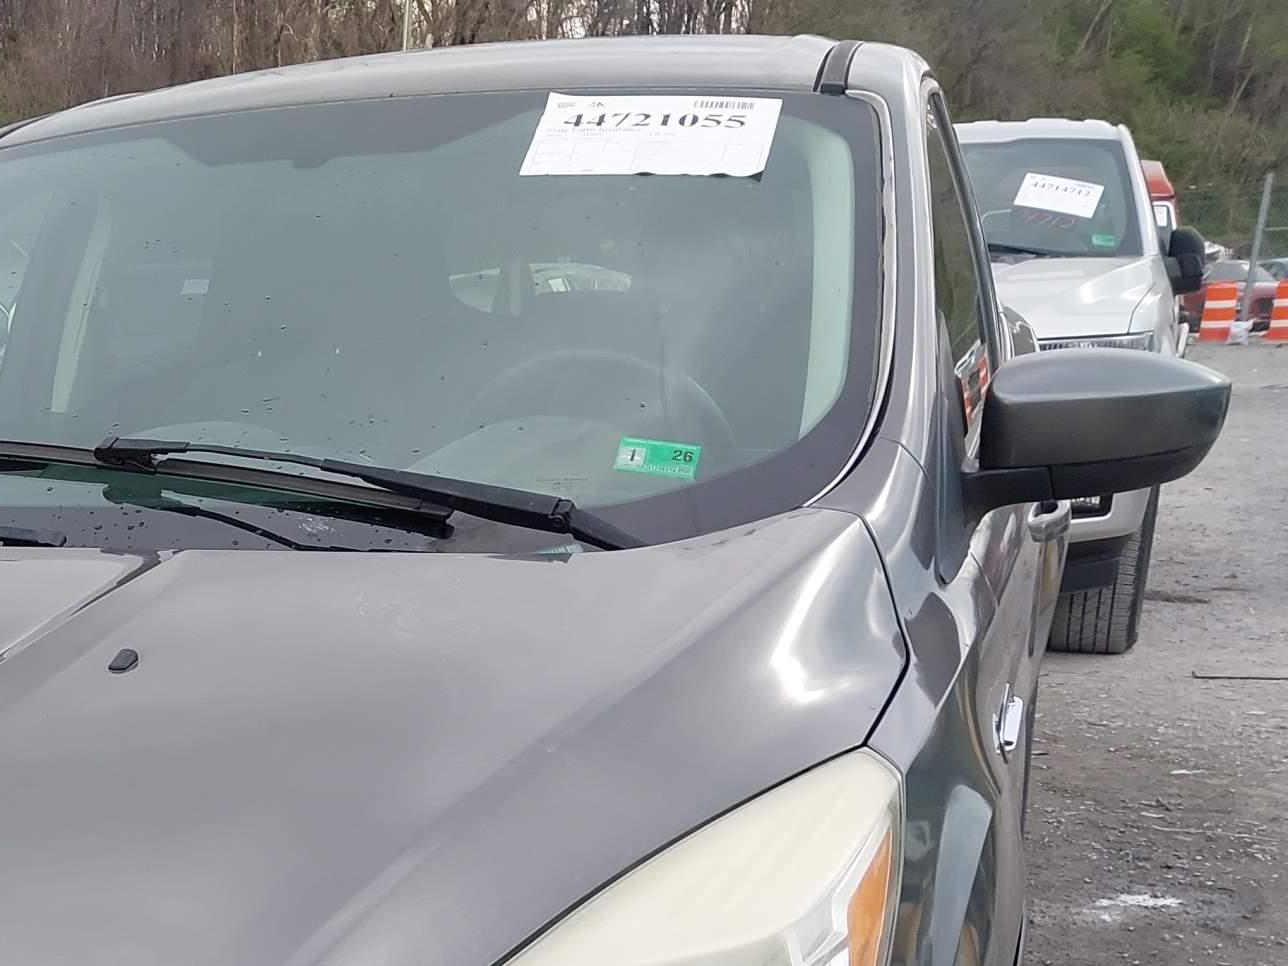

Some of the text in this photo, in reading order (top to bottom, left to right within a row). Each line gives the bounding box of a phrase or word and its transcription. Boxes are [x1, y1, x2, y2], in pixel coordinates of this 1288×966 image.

[563, 112, 747, 128] 44721055
[628, 448, 694, 462] 1 26
